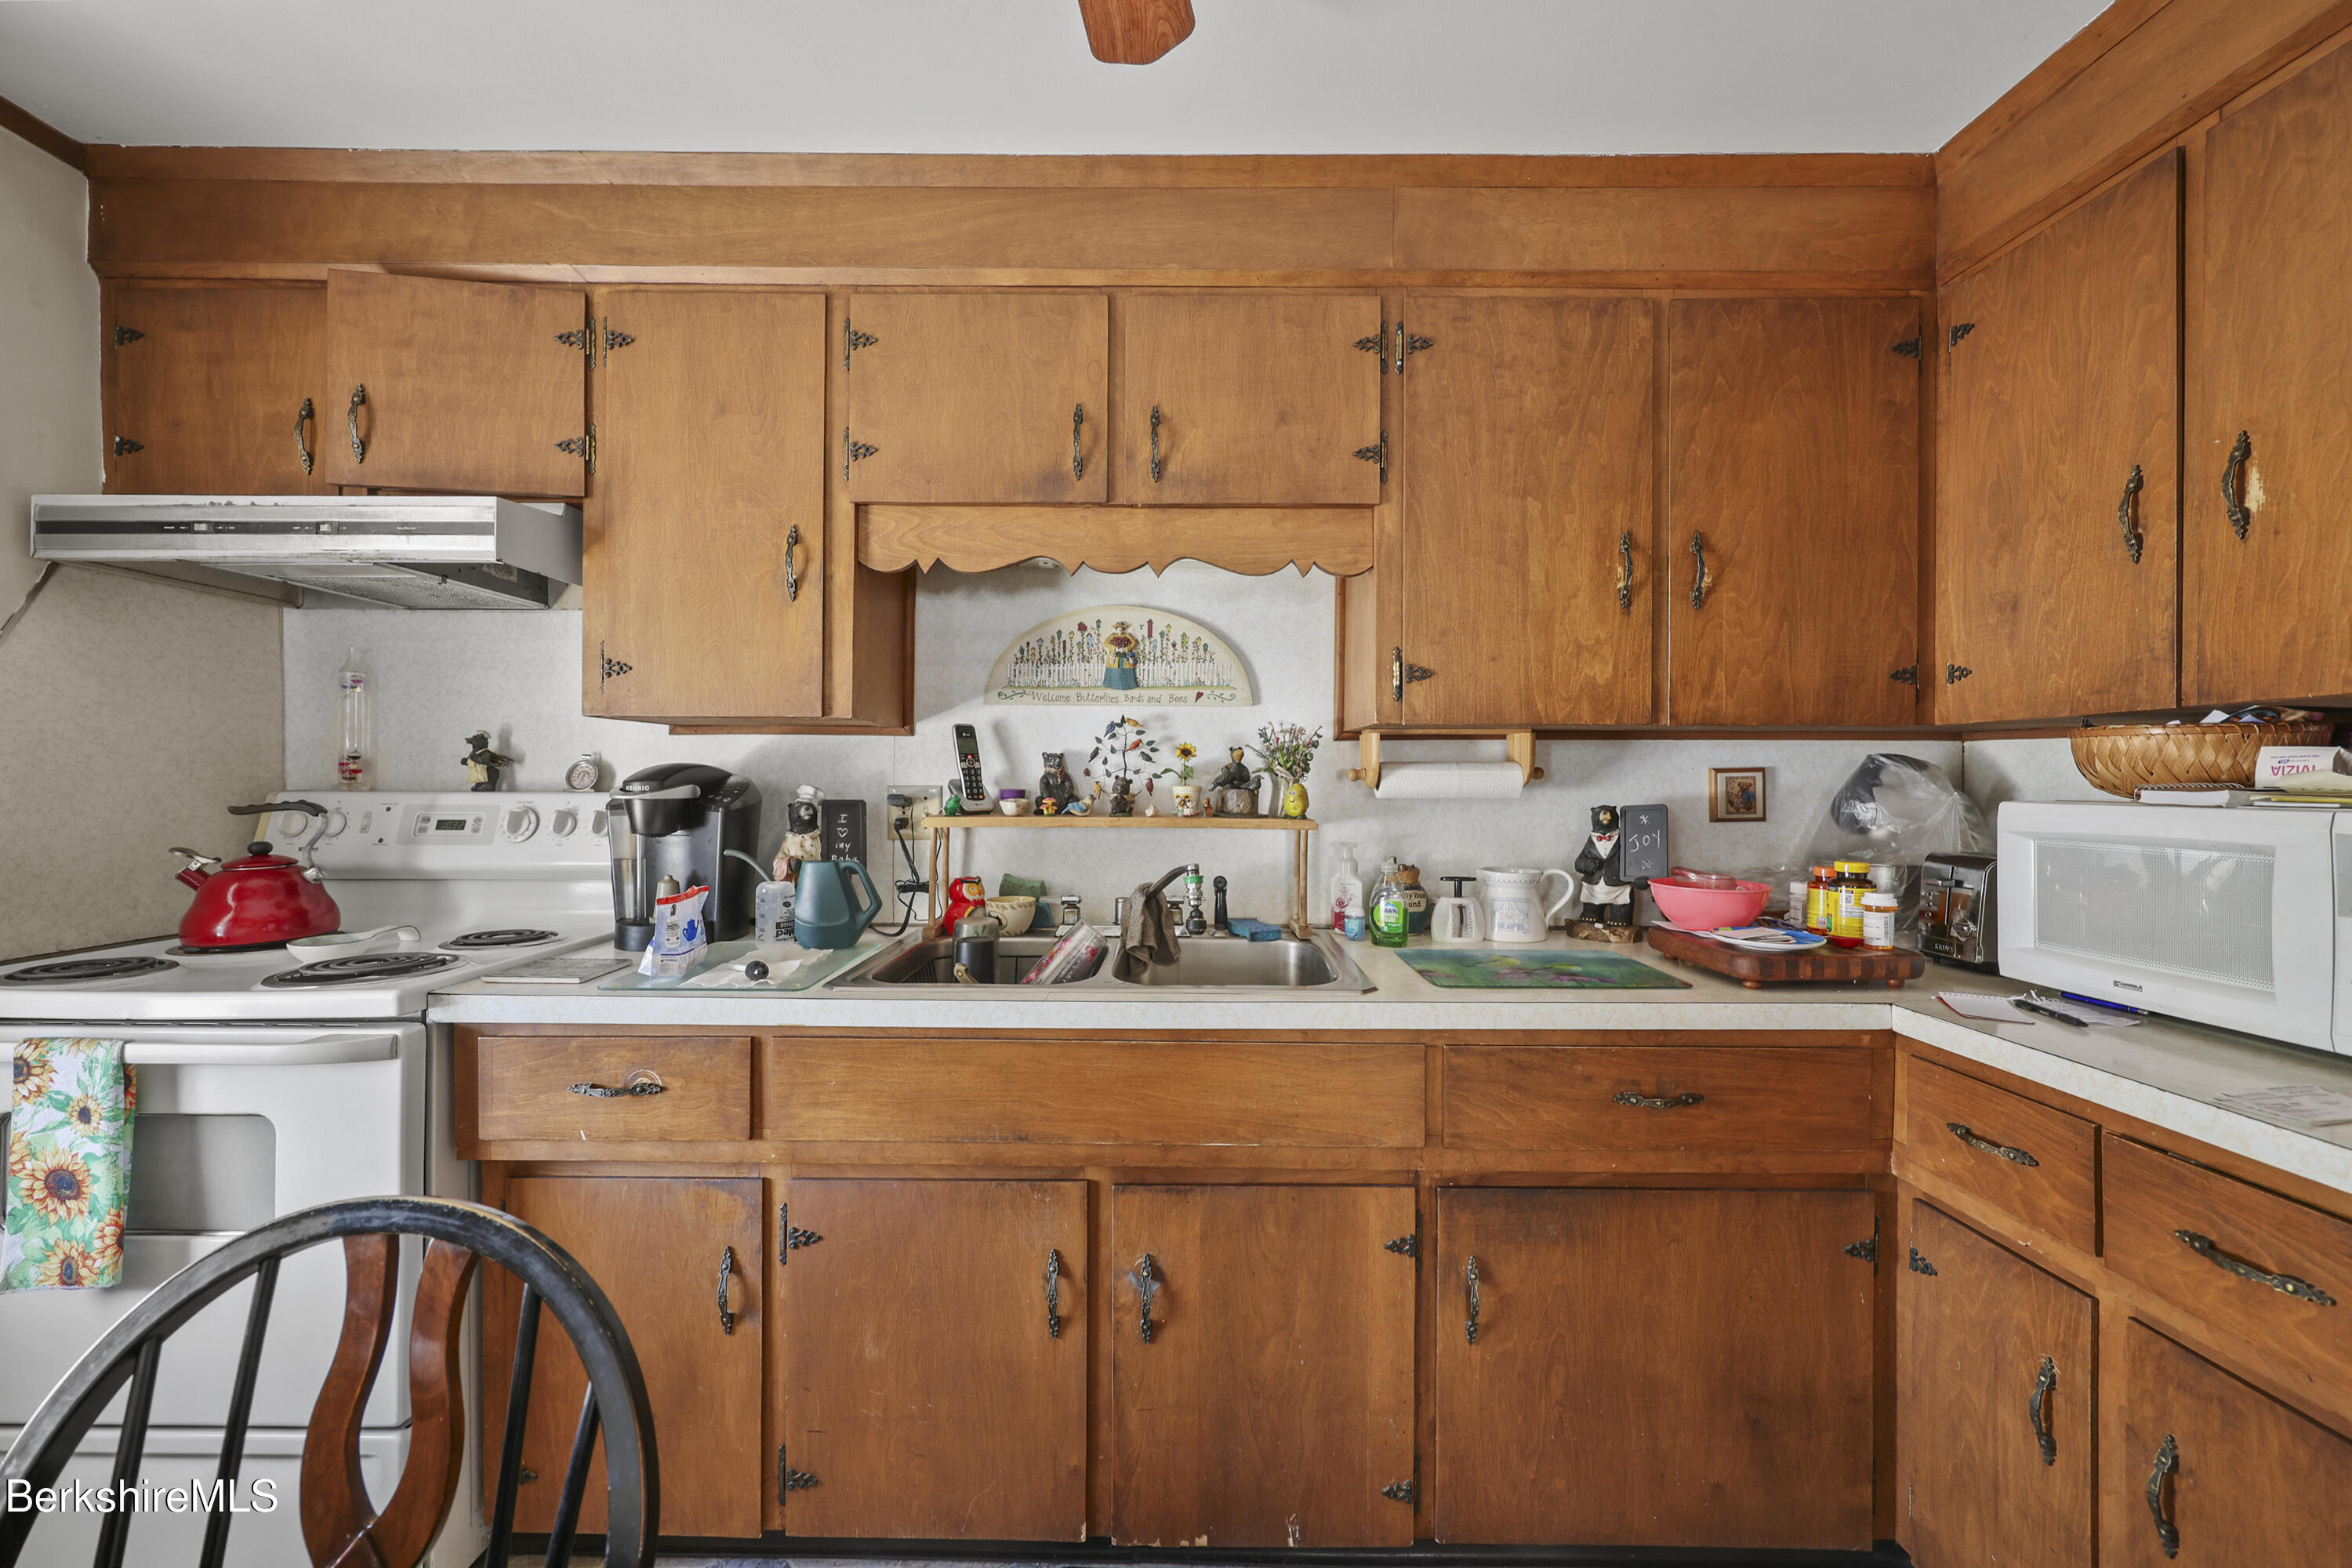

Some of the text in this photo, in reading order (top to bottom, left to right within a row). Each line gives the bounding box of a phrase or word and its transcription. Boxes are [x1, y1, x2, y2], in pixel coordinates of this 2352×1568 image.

[1029, 691, 1070, 702] Welcome
[1147, 693, 1162, 703] and
[1168, 694, 1188, 703] Bees
[838, 814, 848, 823] I
[1628, 830, 1660, 852] JOY
[835, 842, 851, 853] my
